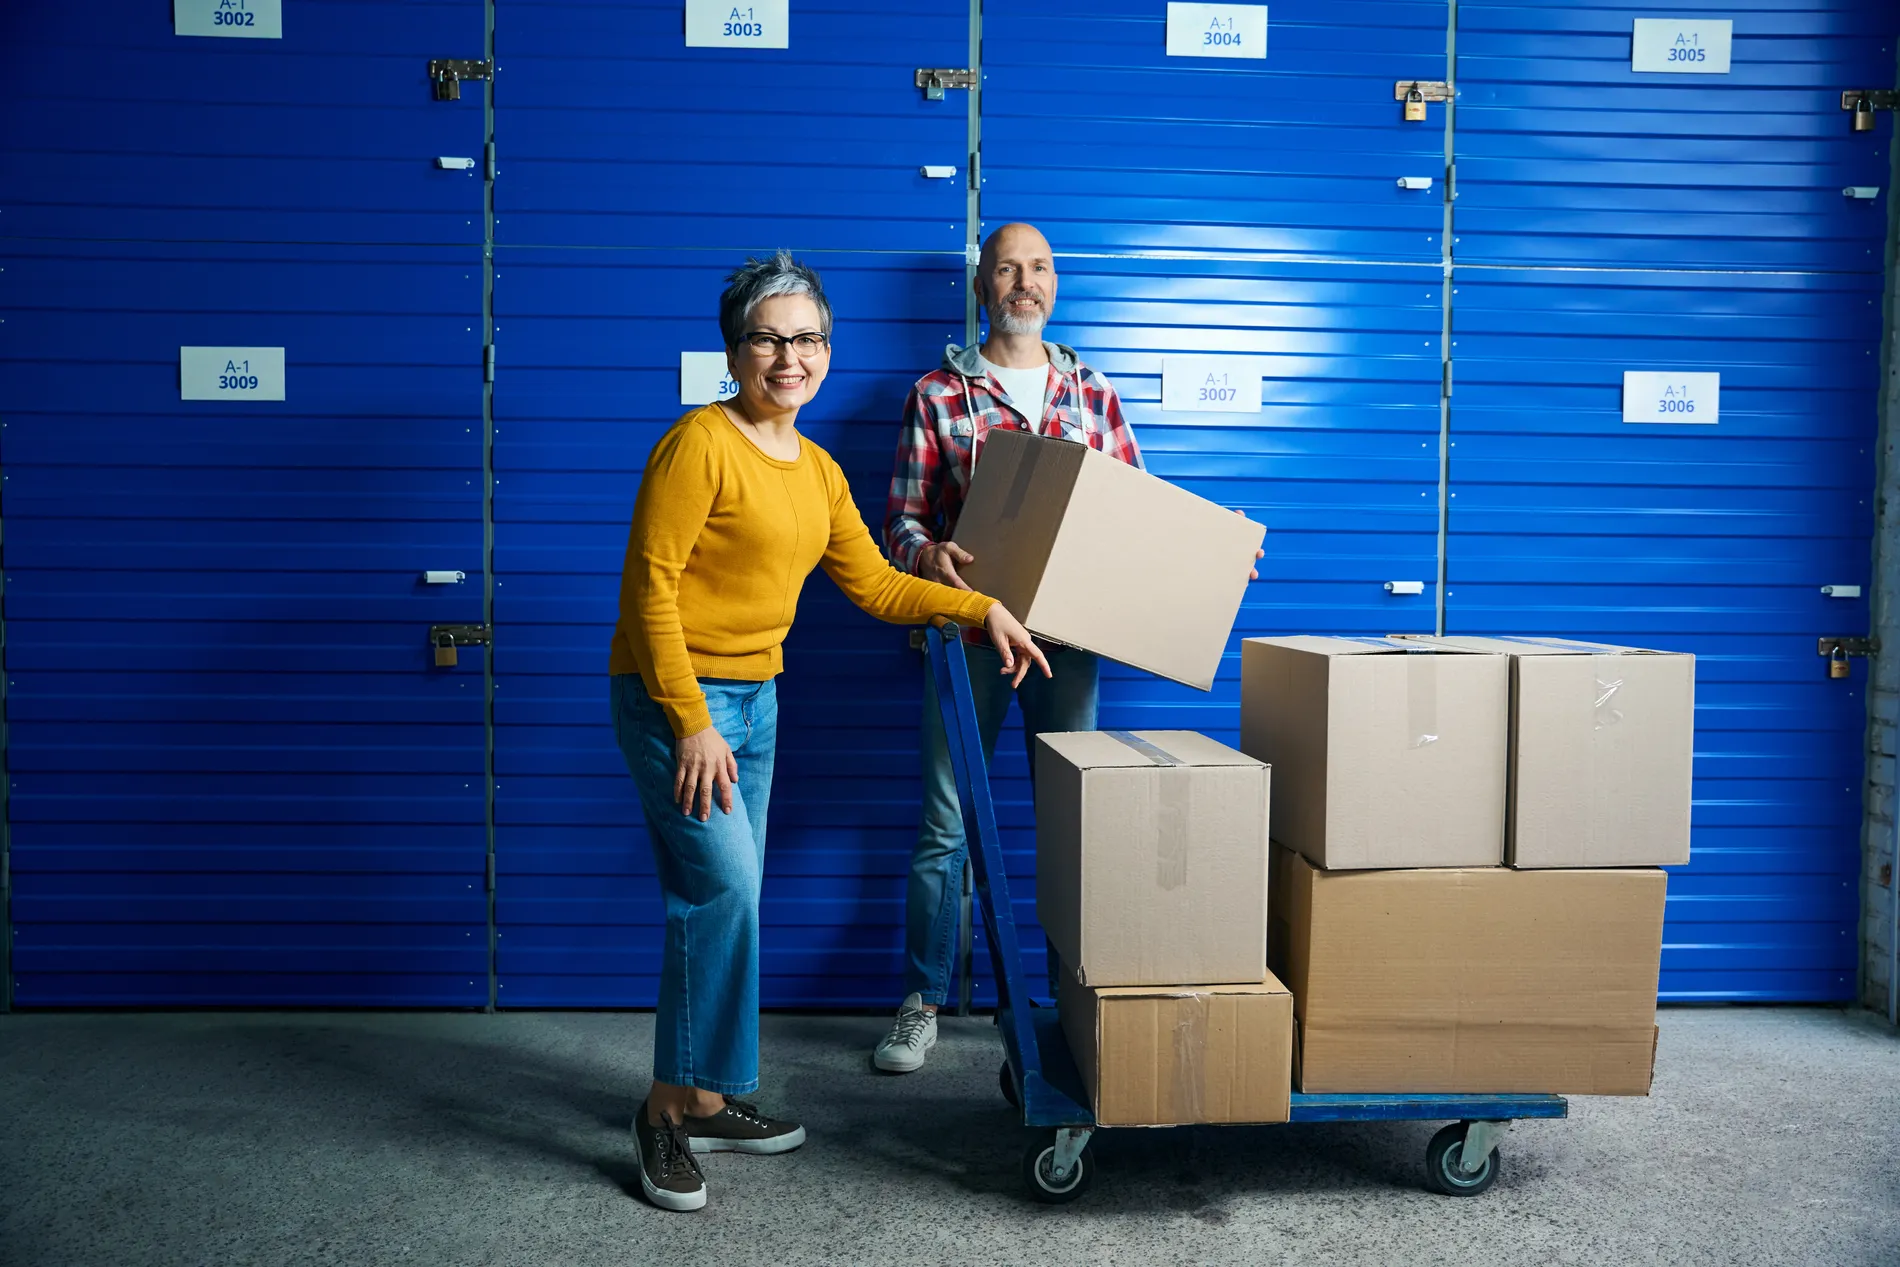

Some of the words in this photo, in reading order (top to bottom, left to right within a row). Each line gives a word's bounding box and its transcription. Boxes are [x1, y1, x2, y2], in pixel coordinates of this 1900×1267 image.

[219, 0, 246, 10] A-1
[213, 11, 255, 27] 3002
[729, 7, 754, 21] A-1
[723, 23, 763, 36] 3003
[1209, 16, 1234, 30] A-1
[1203, 32, 1242, 46] 3004
[1675, 32, 1699, 46] A-1
[1667, 48, 1706, 62] 3005
[224, 360, 250, 374] A-1
[218, 375, 259, 390] 3009
[1205, 372, 1229, 386] A-1
[718, 380, 739, 395] 30
[1199, 387, 1237, 401] 3007
[1664, 385, 1687, 398] A-1
[1658, 400, 1695, 413] 3006
